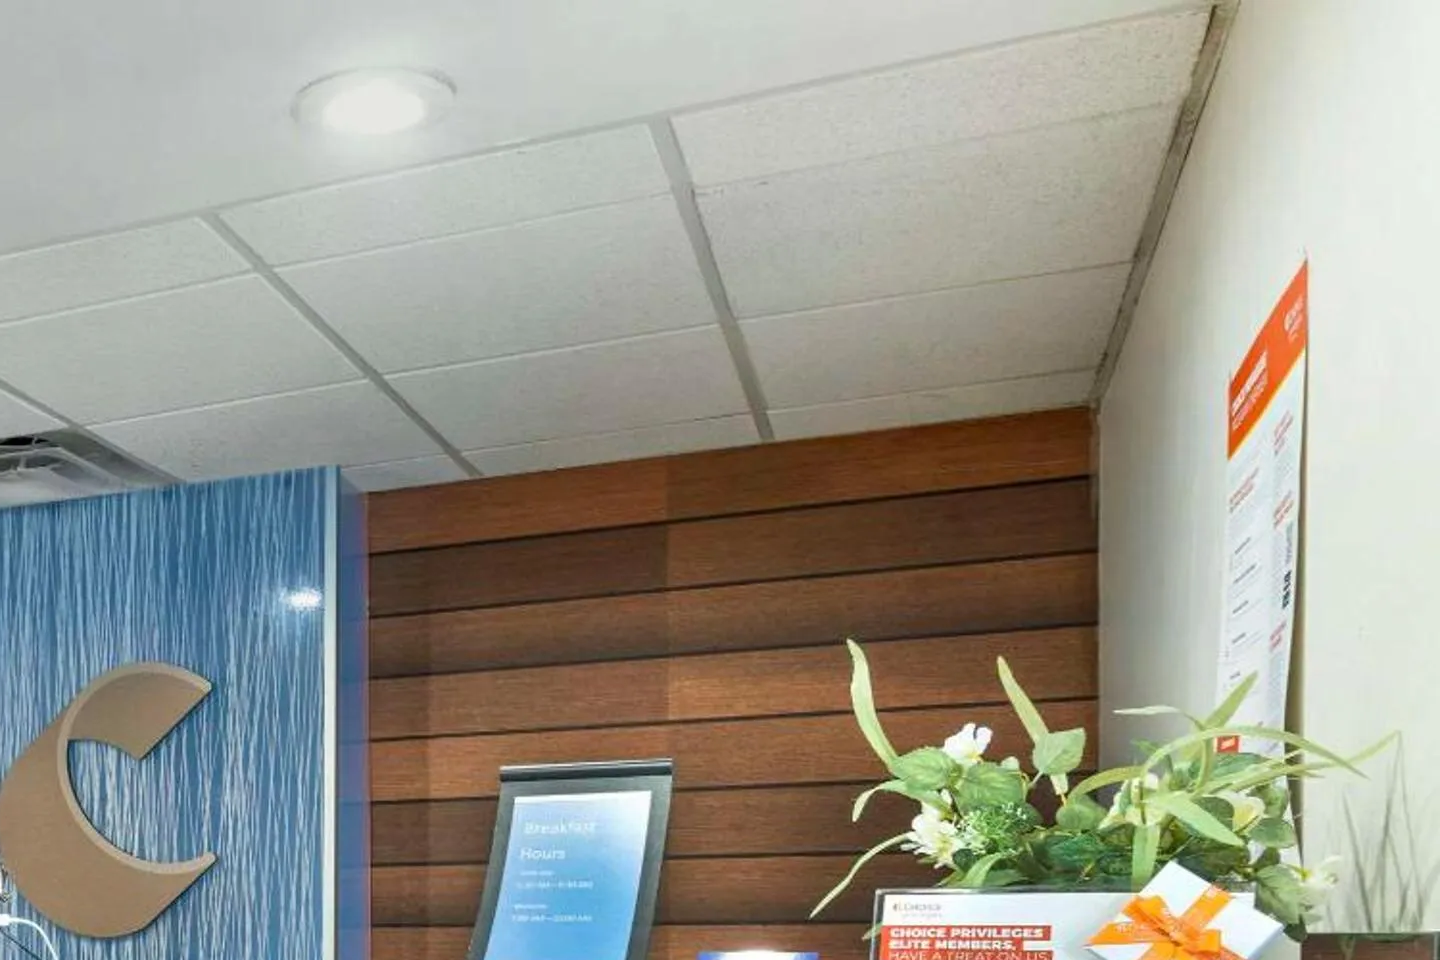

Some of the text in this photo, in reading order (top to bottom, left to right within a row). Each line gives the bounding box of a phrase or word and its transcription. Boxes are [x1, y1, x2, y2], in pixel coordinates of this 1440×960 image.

[520, 847, 566, 860] Hours
[889, 927, 1044, 938] CHOICE PRIVILEGES
[889, 939, 931, 949] ELITE
[889, 952, 928, 960] HAVE
[930, 952, 942, 960] A
